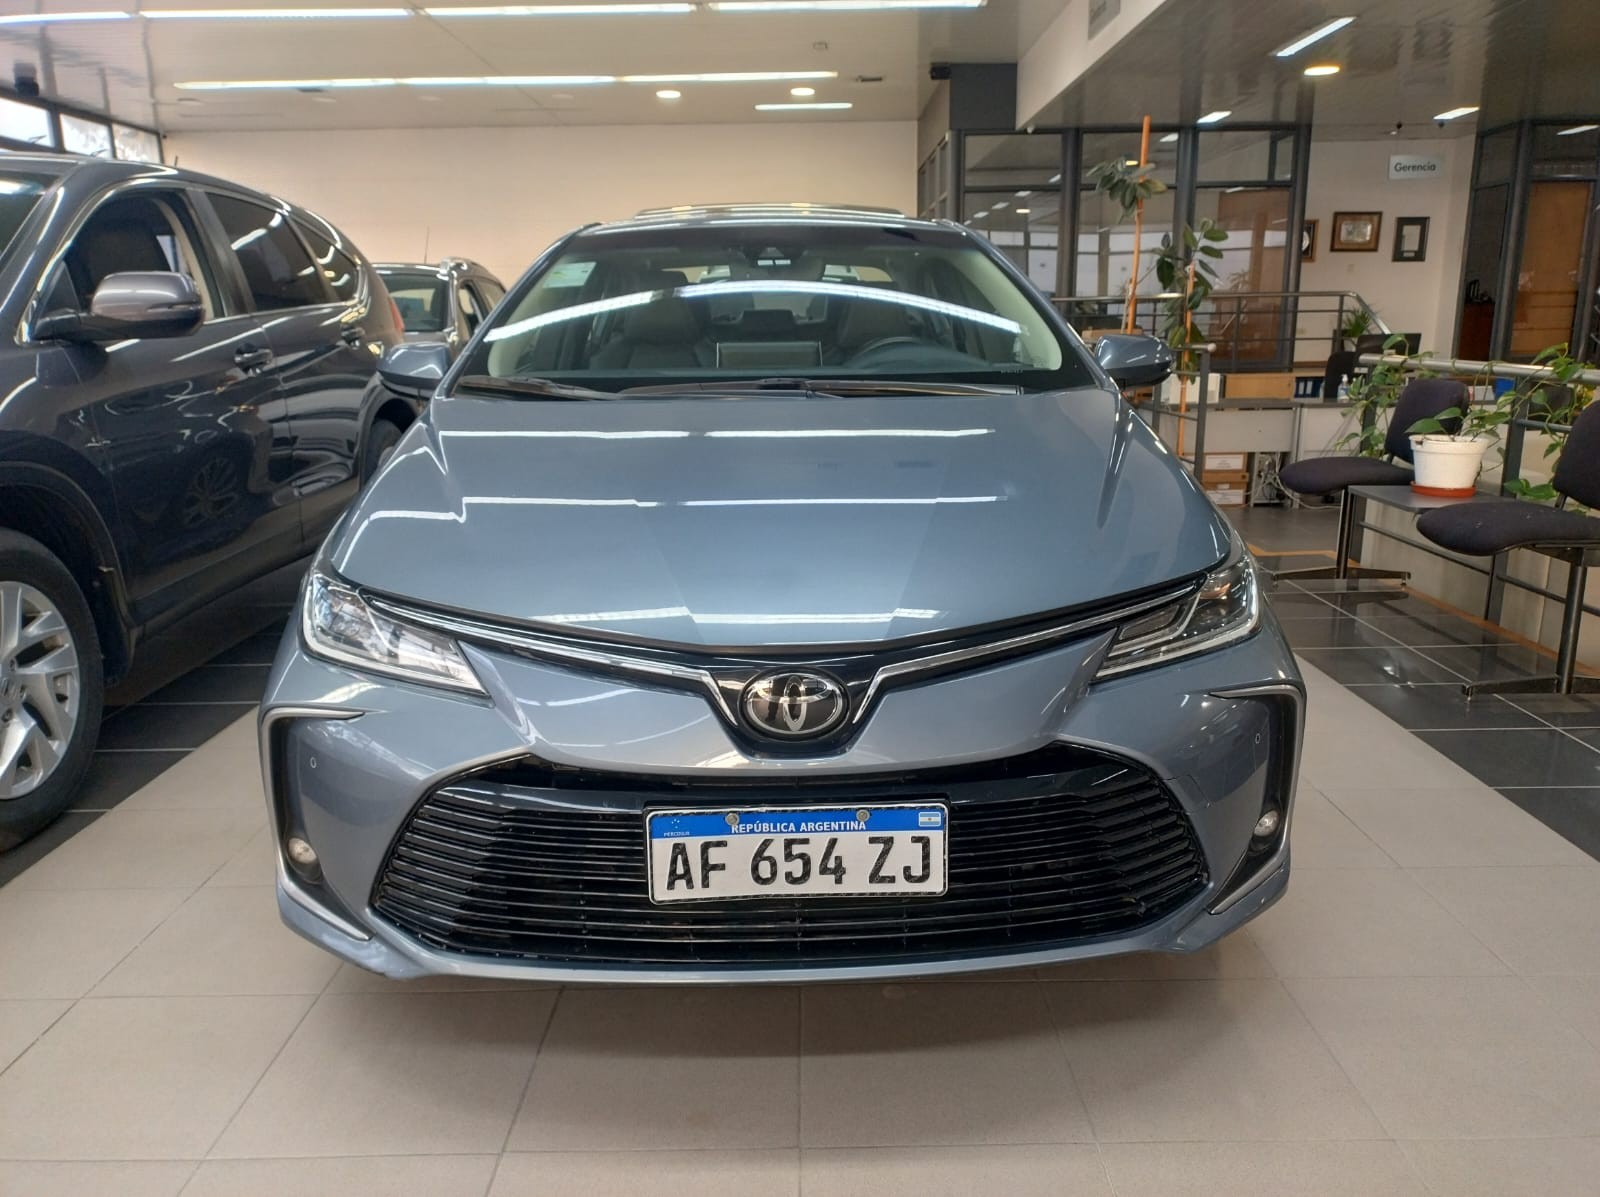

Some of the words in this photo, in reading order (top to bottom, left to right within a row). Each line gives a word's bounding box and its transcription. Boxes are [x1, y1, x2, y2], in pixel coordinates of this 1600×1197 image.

[1394, 161, 1436, 172] Gerencia
[731, 820, 796, 834] REPÚBLICA
[799, 819, 867, 832] ARGENTINA
[666, 840, 728, 890] AF
[750, 837, 846, 885] 654
[868, 836, 931, 884] ZJ
